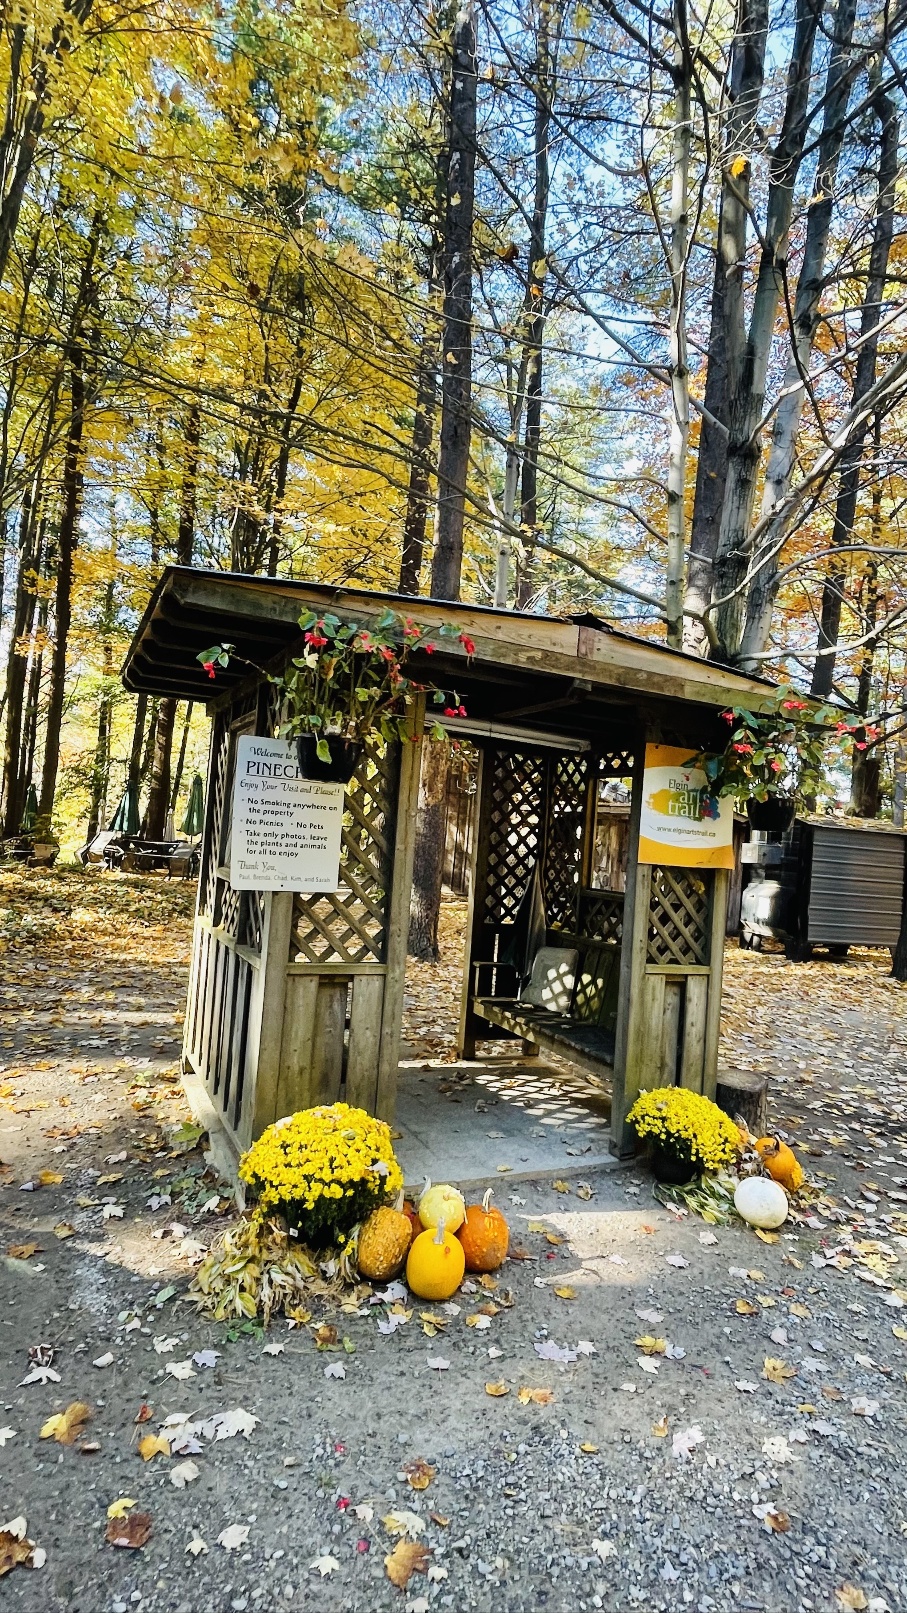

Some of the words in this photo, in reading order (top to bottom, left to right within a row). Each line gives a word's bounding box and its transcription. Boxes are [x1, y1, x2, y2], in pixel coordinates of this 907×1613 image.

[250, 747, 283, 758] Welcome
[240, 779, 258, 791] Enjoy
[261, 781, 277, 791] Your
[281, 783, 298, 791] Visit
[669, 779, 688, 791] Elgin
[261, 799, 290, 808] Smoking
[293, 802, 326, 811] anywhere
[669, 800, 699, 817] trail
[263, 809, 294, 817] property
[259, 819, 283, 827] Picnics
[264, 831, 278, 840] only
[261, 840, 282, 848] plants
[238, 861, 258, 870] Thank
